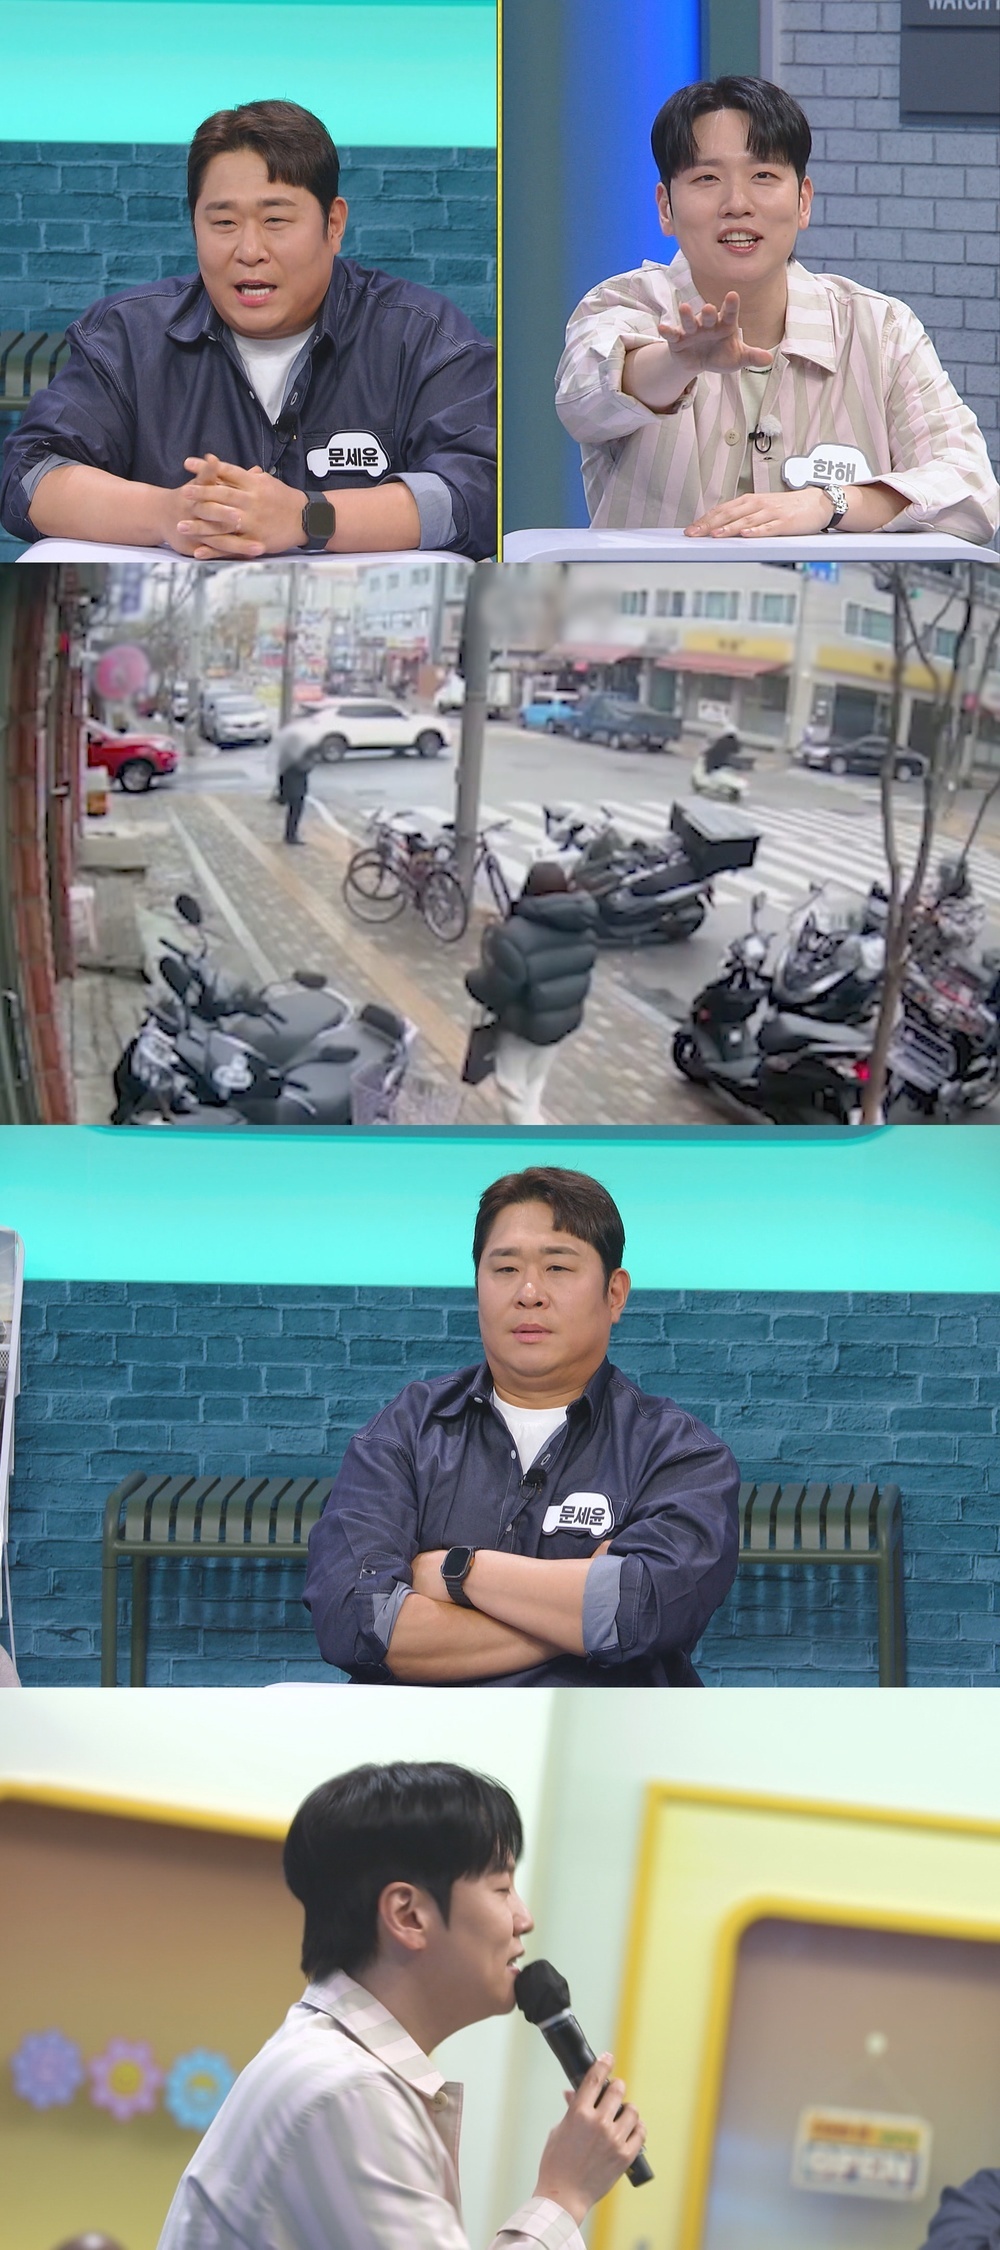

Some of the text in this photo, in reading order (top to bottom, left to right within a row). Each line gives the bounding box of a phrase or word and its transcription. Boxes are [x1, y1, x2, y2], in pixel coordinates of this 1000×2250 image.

[328, 447, 379, 467] 문세윤
[813, 459, 856, 483] 한해
[559, 1505, 606, 1526] 문세윤
